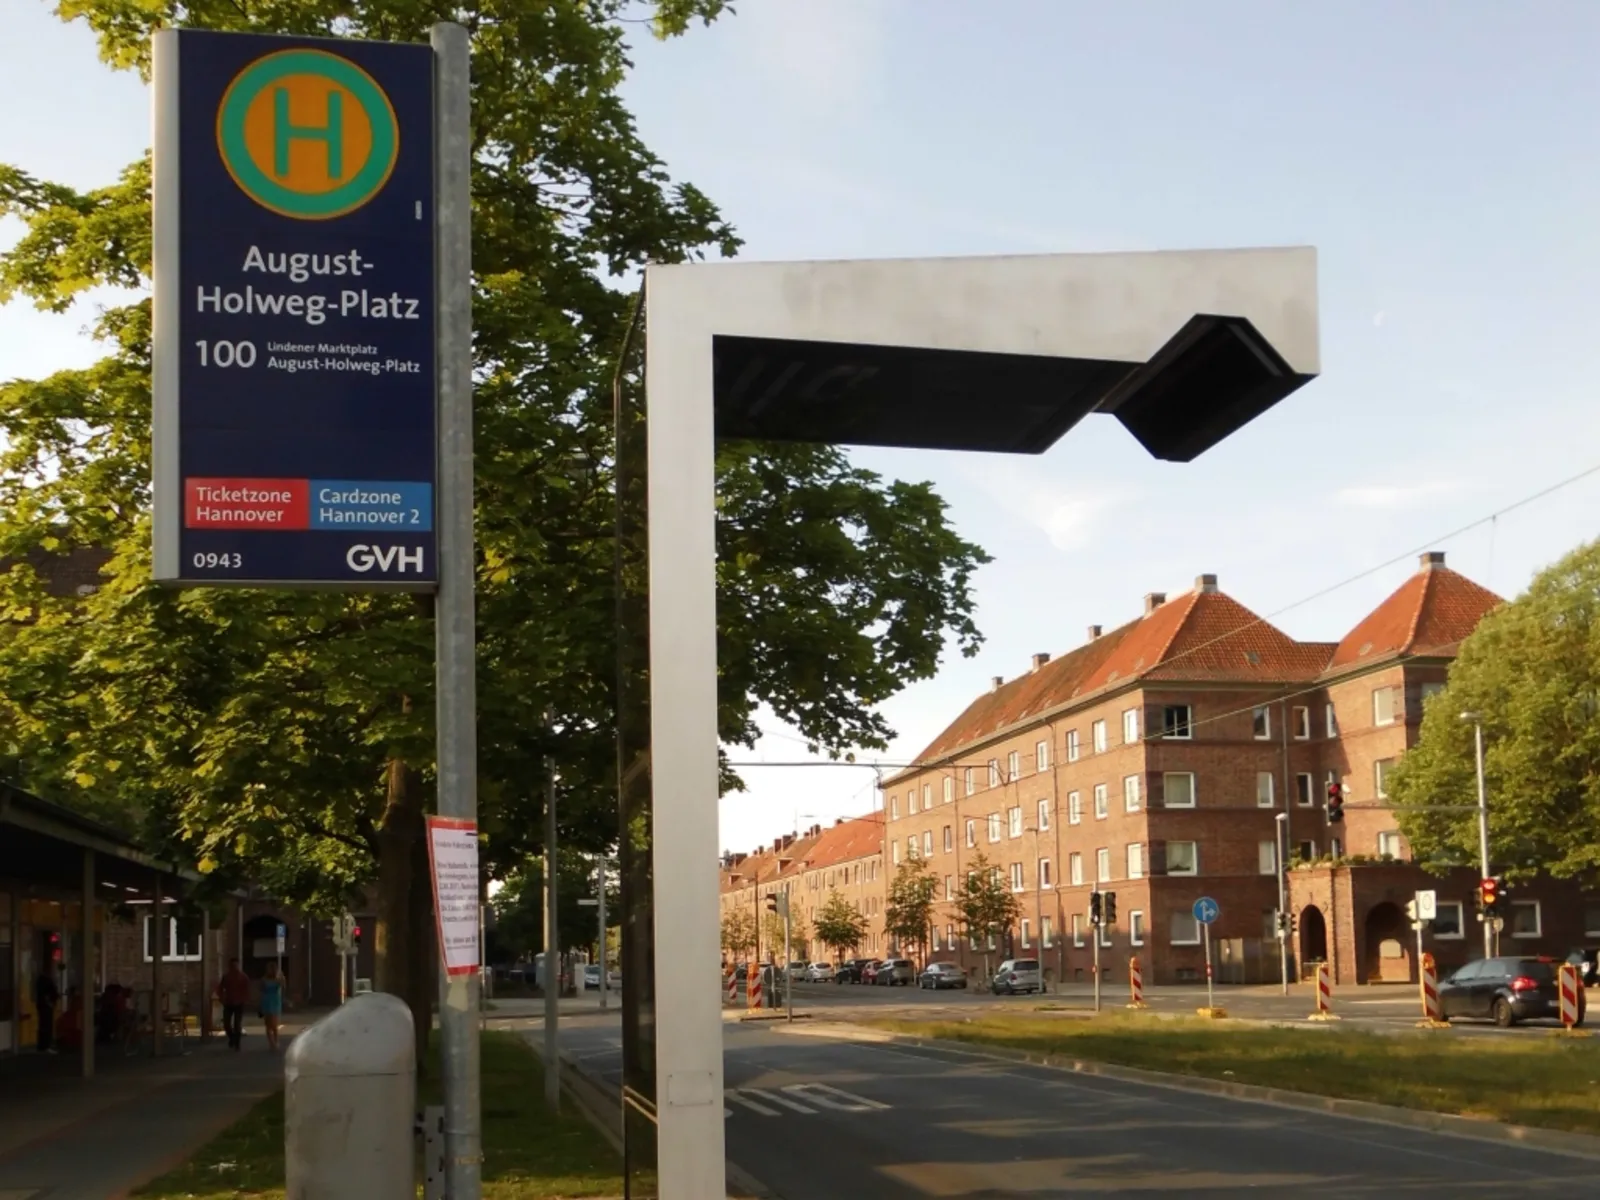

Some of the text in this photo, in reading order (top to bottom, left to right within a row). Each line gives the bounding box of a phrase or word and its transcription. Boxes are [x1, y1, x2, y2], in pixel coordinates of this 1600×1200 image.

[275, 87, 343, 180] H
[242, 245, 374, 283] August-
[197, 285, 420, 326] Holweg-Platz
[195, 339, 257, 368] 100
[267, 341, 378, 356] Lindener Marktplatz
[267, 356, 420, 376] August-Holweg-Platz
[195, 485, 292, 503] Ticketzone
[319, 488, 402, 506] Cardzone
[196, 506, 284, 523] Hannover
[319, 508, 420, 525] Hannover 2
[193, 552, 242, 569] 0943
[346, 544, 424, 573] GVH
